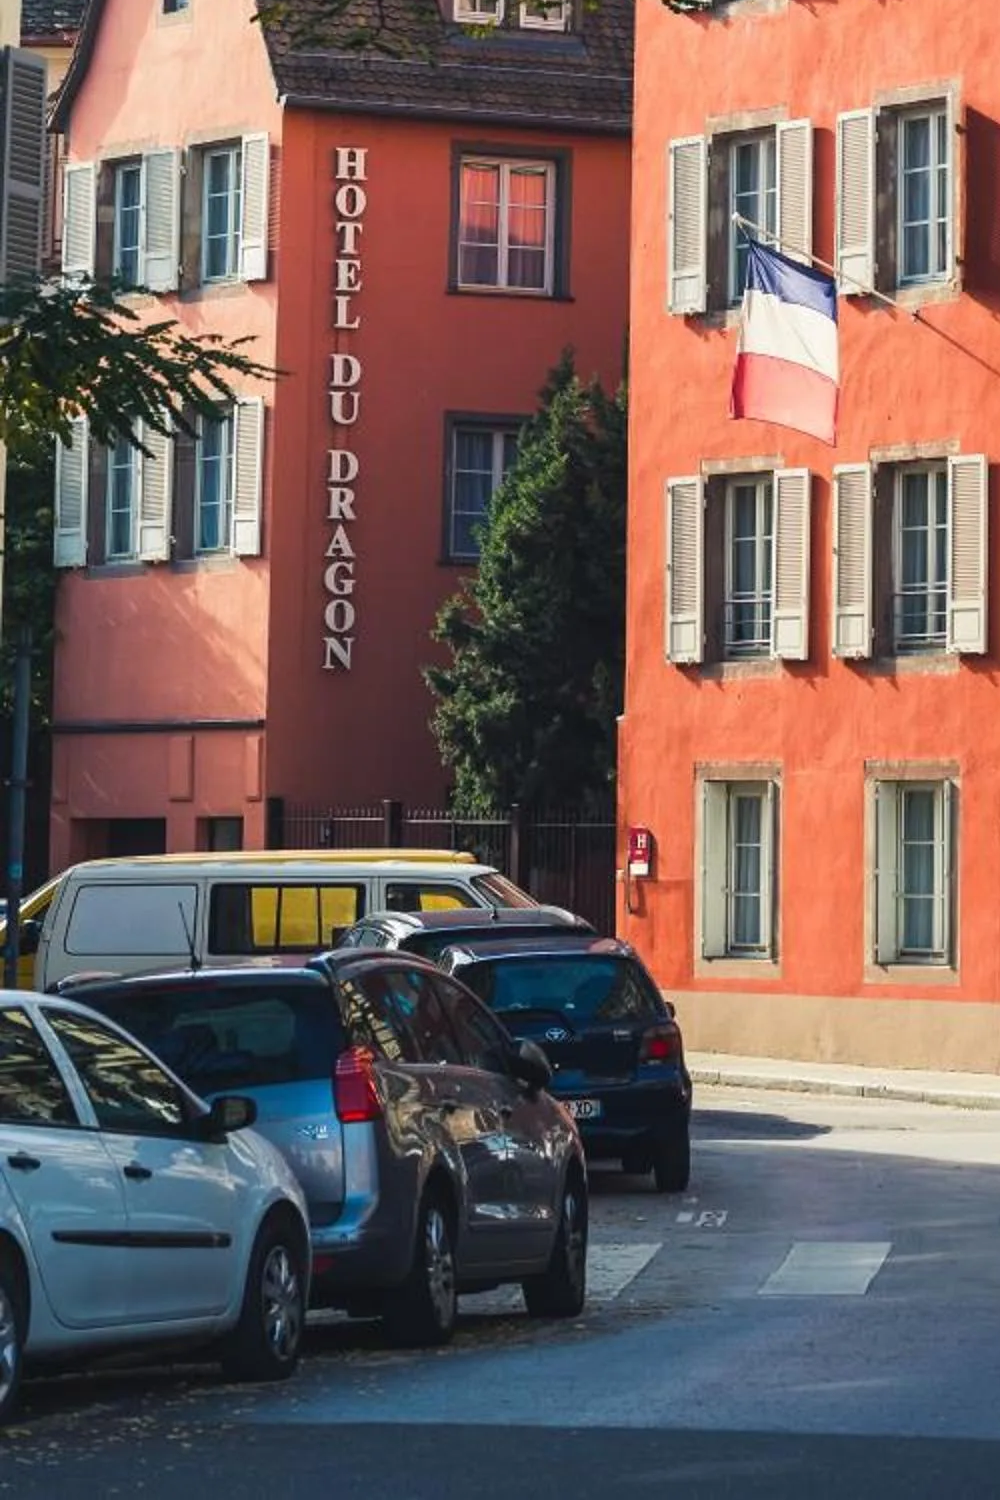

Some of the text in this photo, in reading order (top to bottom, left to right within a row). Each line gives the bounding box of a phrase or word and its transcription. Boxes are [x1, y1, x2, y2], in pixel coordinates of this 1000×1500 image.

[321, 146, 369, 671] HOTEL DU DRAGON
